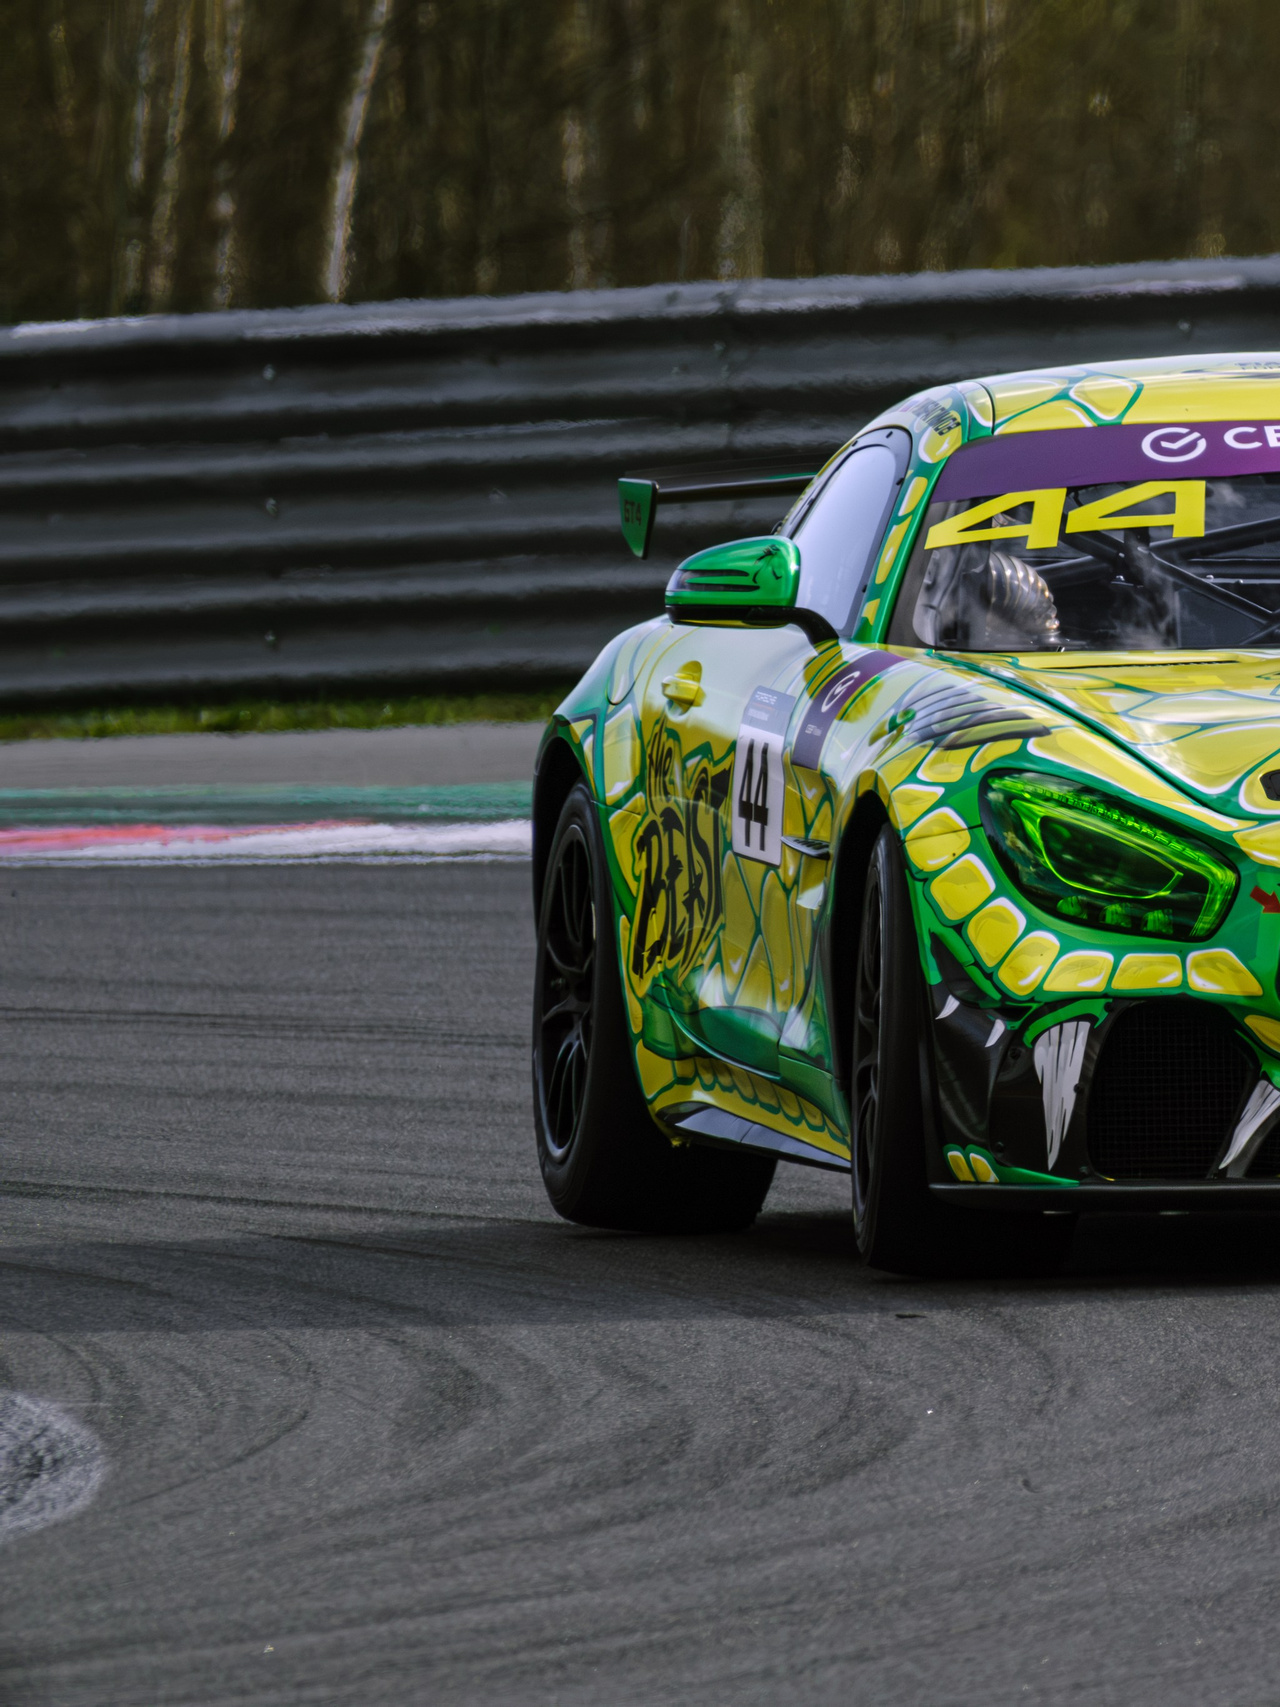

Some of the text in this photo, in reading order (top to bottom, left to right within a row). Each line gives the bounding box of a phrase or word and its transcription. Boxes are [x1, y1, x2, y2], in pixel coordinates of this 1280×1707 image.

[623, 498, 642, 525] GT4
[924, 480, 1206, 549] 44
[738, 738, 769, 851] 44
[631, 761, 733, 981] BEAST
